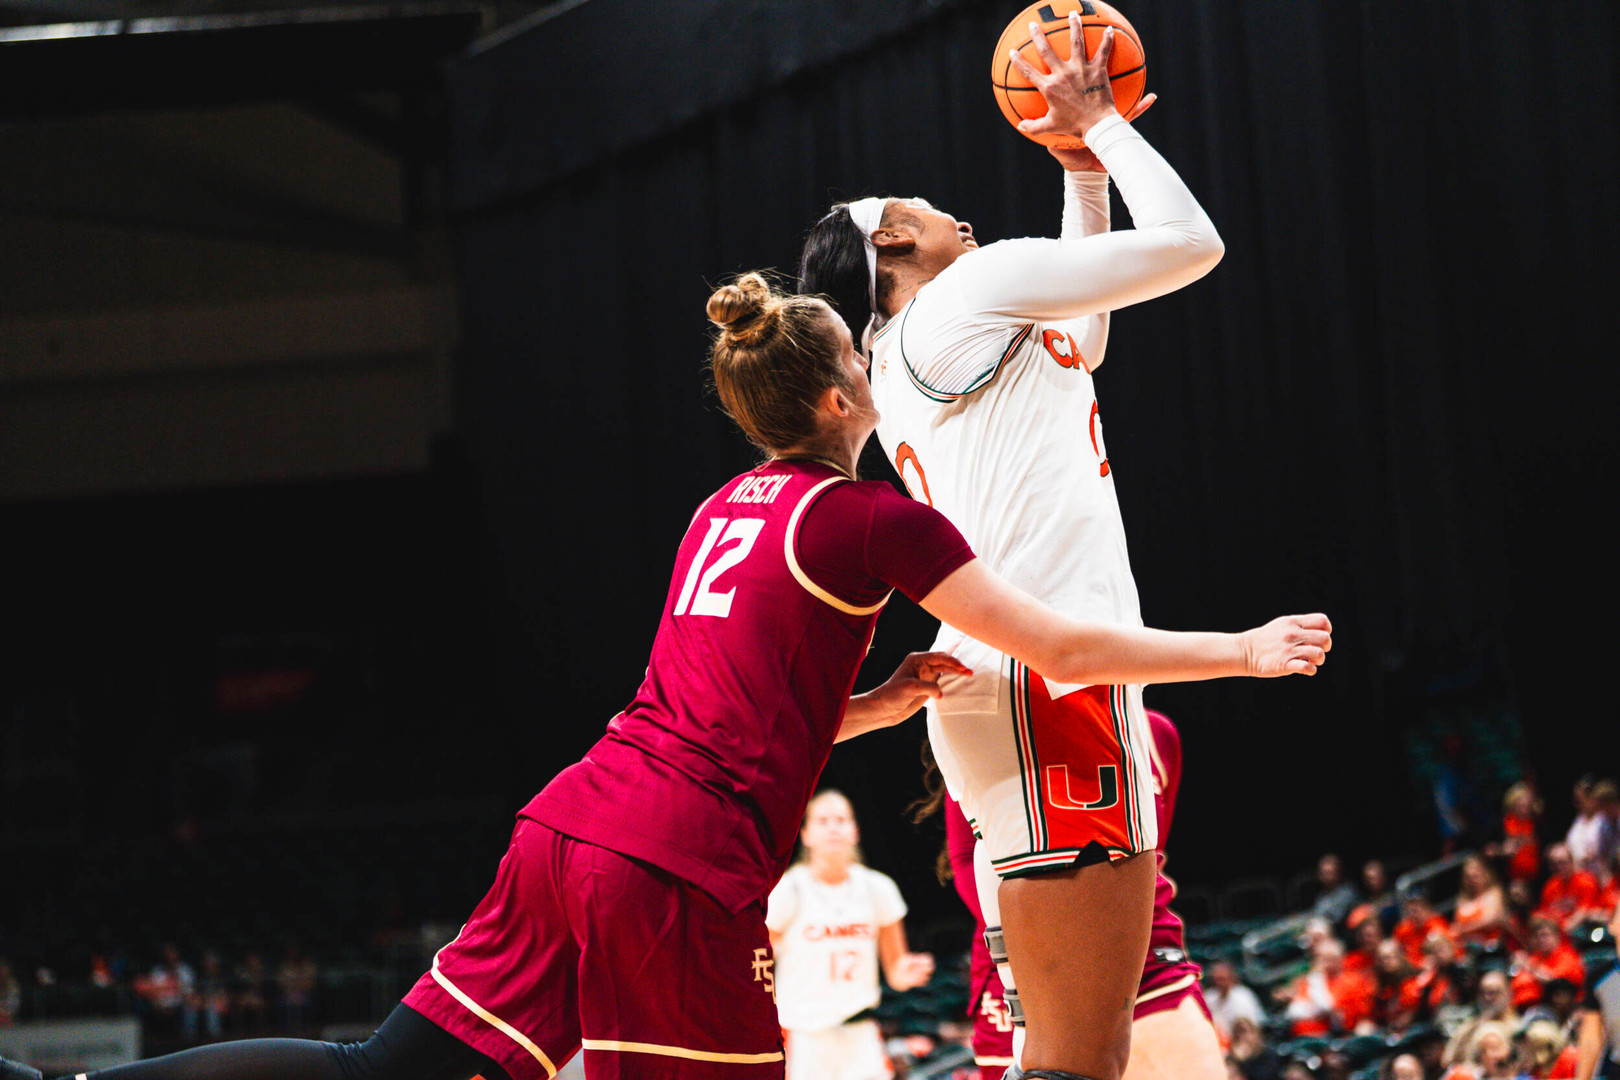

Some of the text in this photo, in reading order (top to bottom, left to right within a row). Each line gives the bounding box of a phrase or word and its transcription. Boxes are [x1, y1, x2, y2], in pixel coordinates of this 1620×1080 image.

[726, 474, 793, 504] RISCH
[673, 517, 766, 618] 12
[1046, 764, 1119, 810] U
[803, 923, 870, 941] CANES
[829, 950, 858, 983] 12
